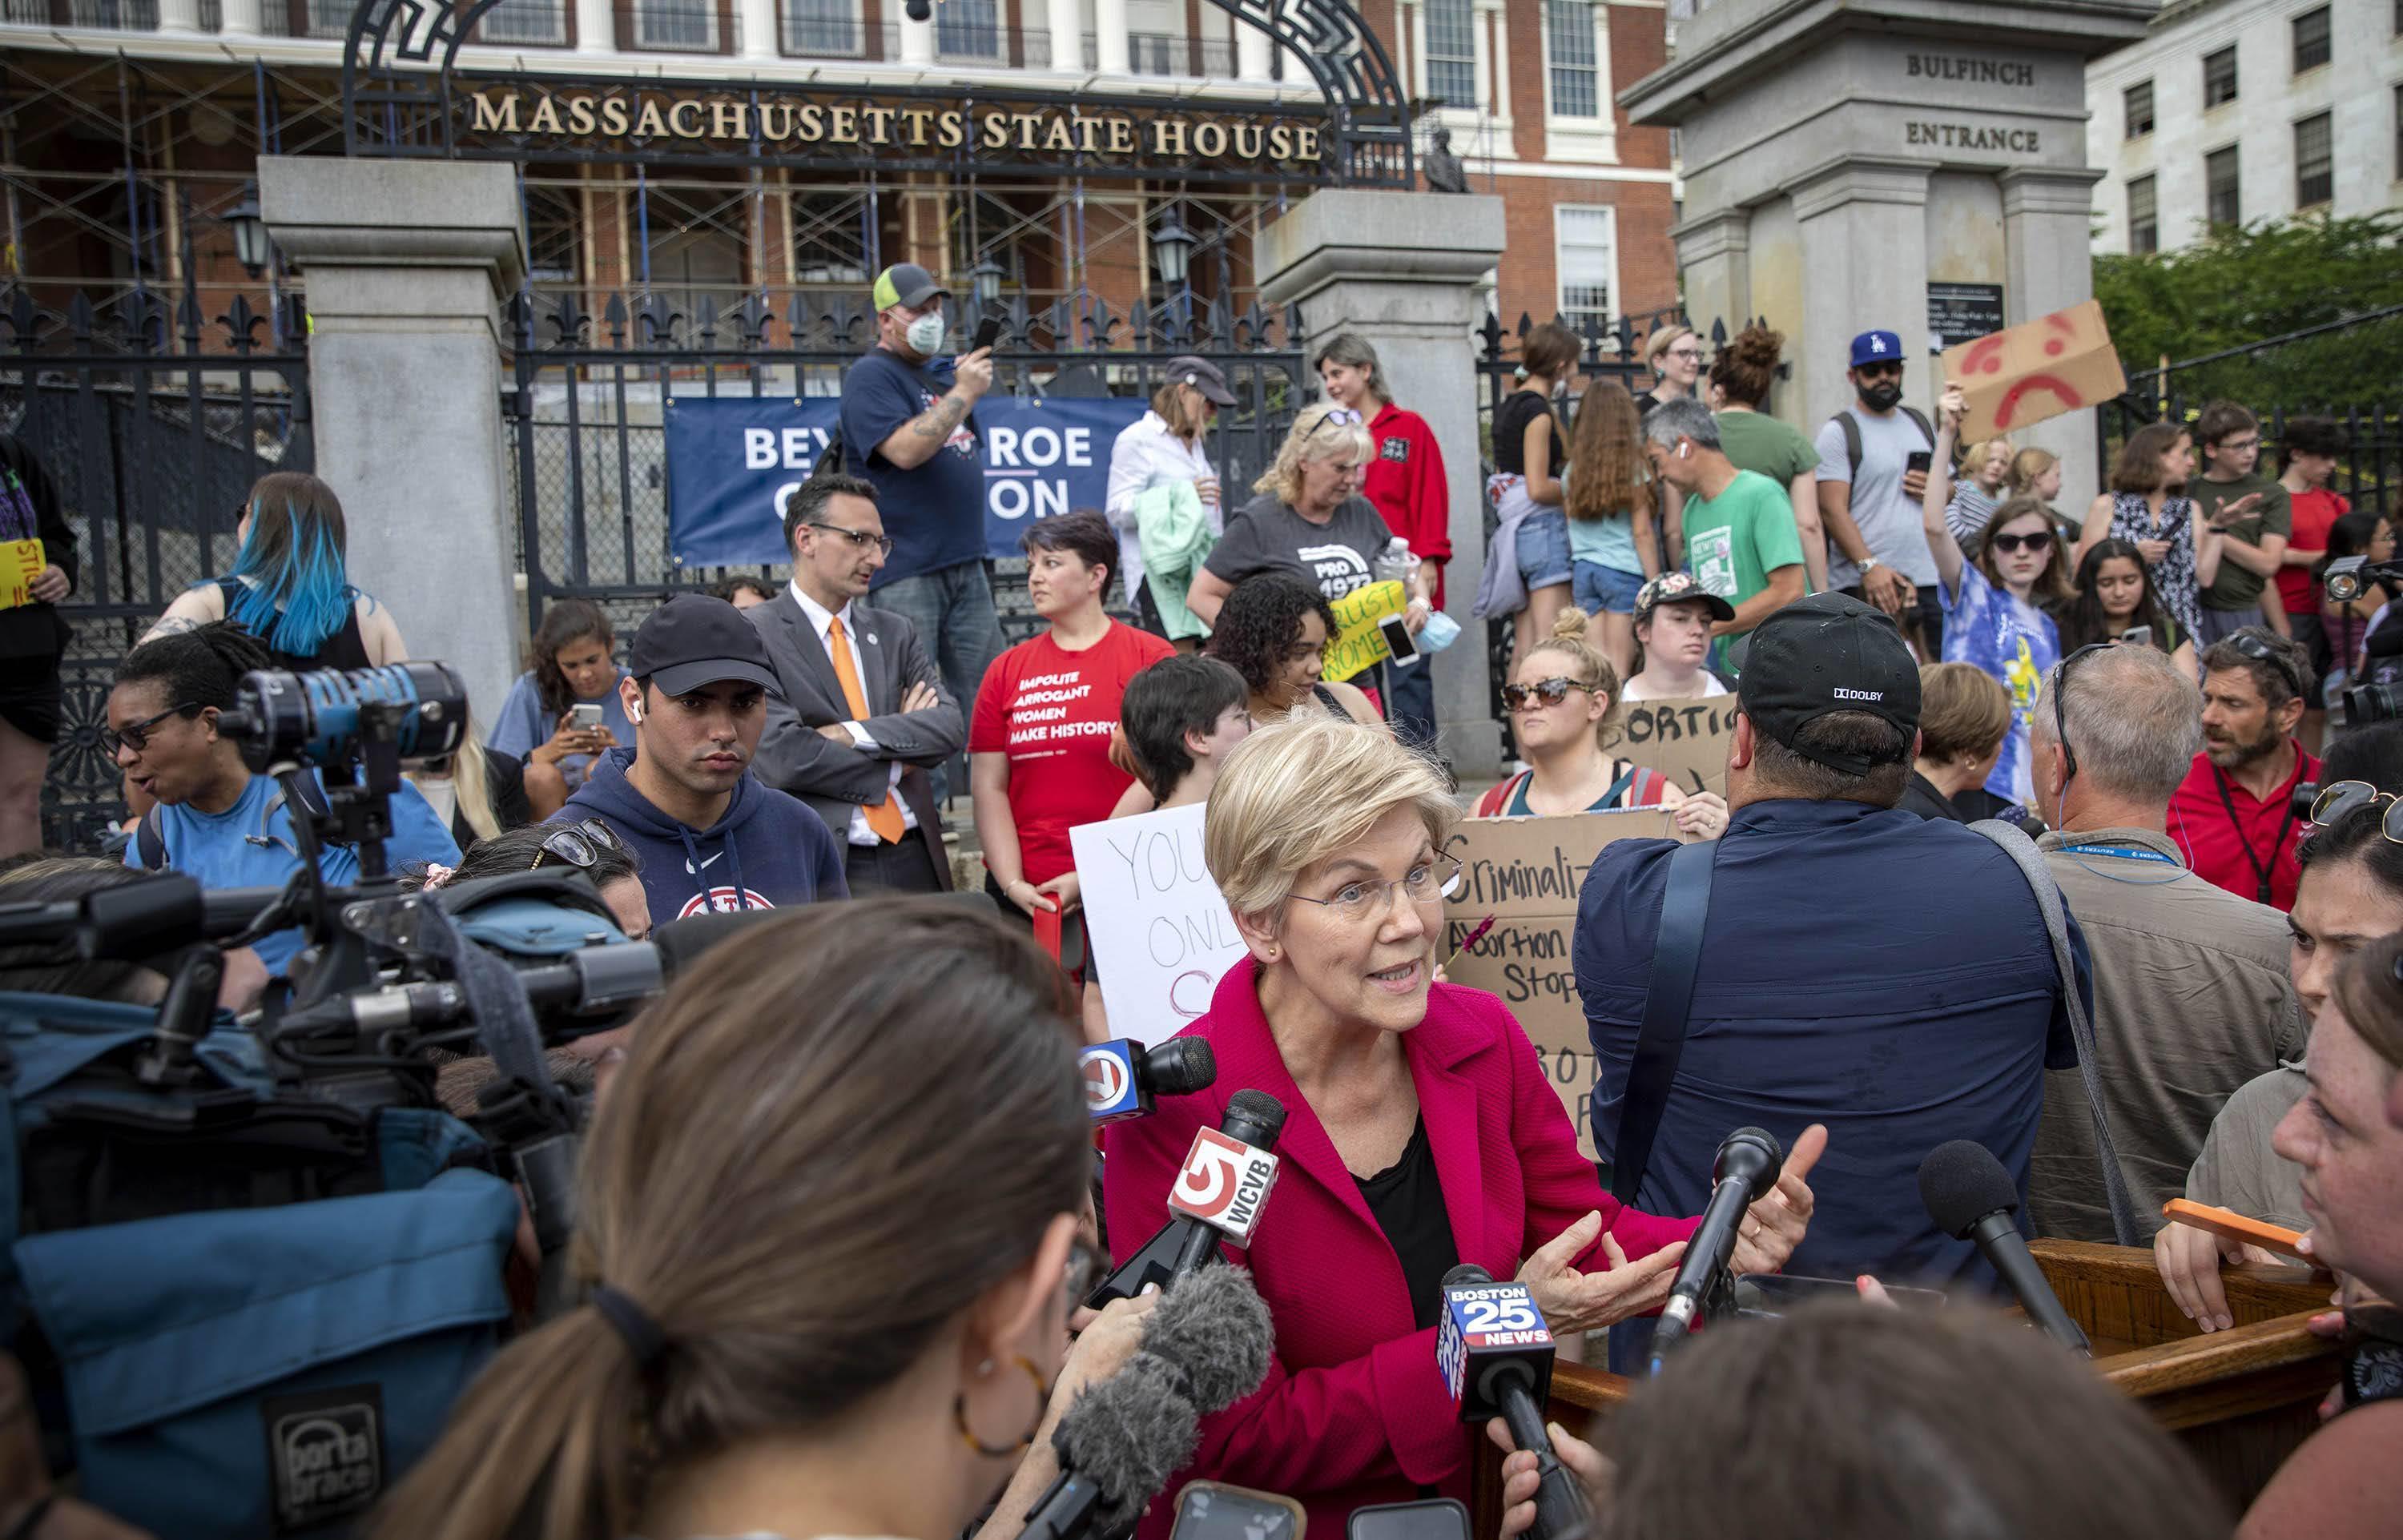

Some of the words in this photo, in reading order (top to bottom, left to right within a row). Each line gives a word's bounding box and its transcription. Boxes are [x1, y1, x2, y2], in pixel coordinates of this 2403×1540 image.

[1906, 55, 2035, 86] BULFINCH
[471, 91, 962, 147] MASSACHUSETTS
[983, 111, 1134, 154] STATE
[1153, 119, 1322, 161] HOUSE
[1906, 123, 2039, 152] ENTRANCE
[988, 427, 1093, 467] ROE
[988, 479, 1069, 519] ON
[1314, 560, 1350, 578] PRO
[1333, 582, 1395, 629] RUST
[1322, 627, 1389, 682] WOME
[1013, 685, 1091, 707] ARROGANT
[1018, 671, 1080, 691] IMPOLITE
[1850, 690, 1883, 701] DOLBY
[1012, 706, 1067, 724] WOMEN
[1616, 705, 1733, 746] ORTI
[1010, 726, 1048, 745] MAKE
[1050, 721, 1118, 739] HISTORY
[1107, 827, 1206, 900] YOU
[1440, 834, 1591, 904] Criminali
[1149, 909, 1242, 968] ONL
[1227, 1159, 1270, 1224] WCVB
[1451, 1287, 1527, 1301] BOSTON
[1463, 1298, 1536, 1333] 25
[1485, 1329, 1548, 1345] NEWS
